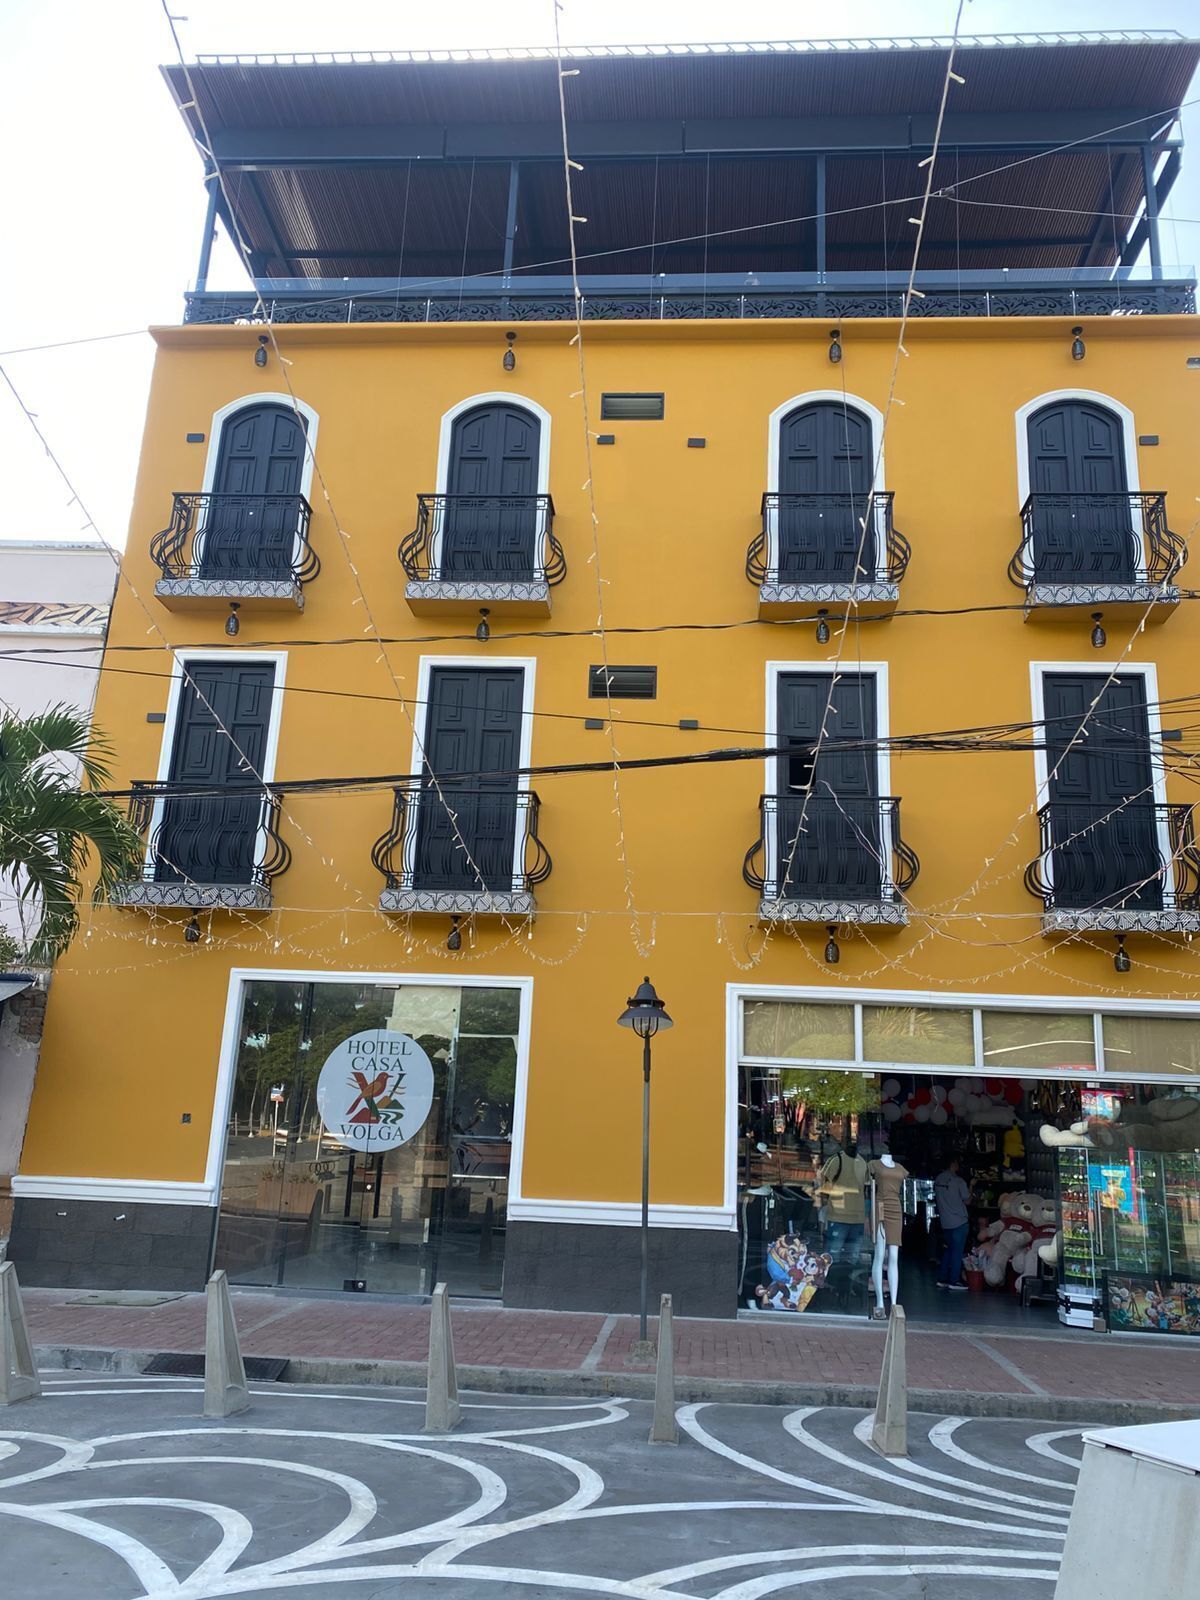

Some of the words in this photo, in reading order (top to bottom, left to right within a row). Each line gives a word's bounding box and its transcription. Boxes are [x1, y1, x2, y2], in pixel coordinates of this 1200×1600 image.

[347, 1040, 412, 1056] HOTEL
[351, 1056, 404, 1072] CASA
[340, 1124, 405, 1141] VOLGA
